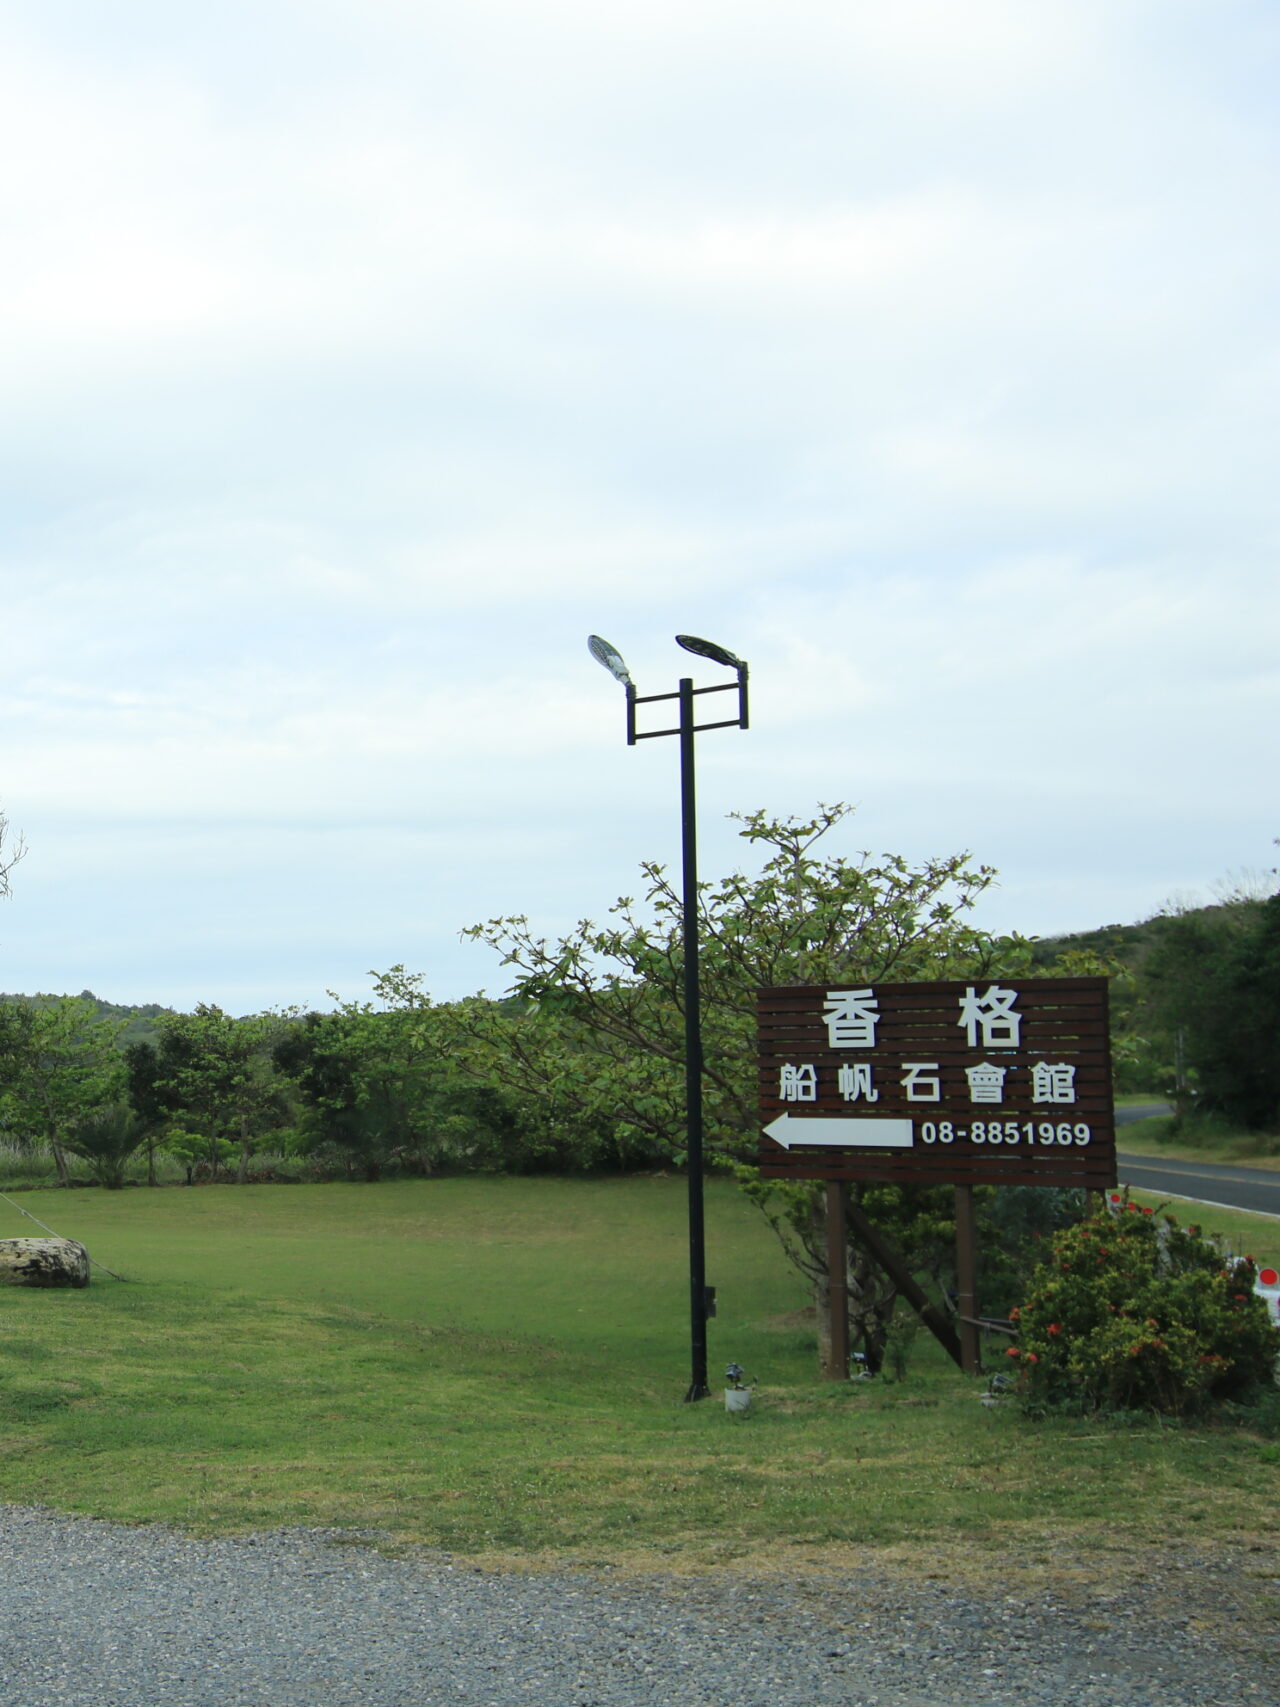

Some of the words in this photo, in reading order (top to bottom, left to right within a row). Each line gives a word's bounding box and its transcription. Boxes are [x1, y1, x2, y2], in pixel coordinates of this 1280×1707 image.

[821, 985, 1022, 1048] 香格
[778, 1061, 1076, 1104] 船帆石會館
[920, 1121, 1090, 1146] 08-8851969
